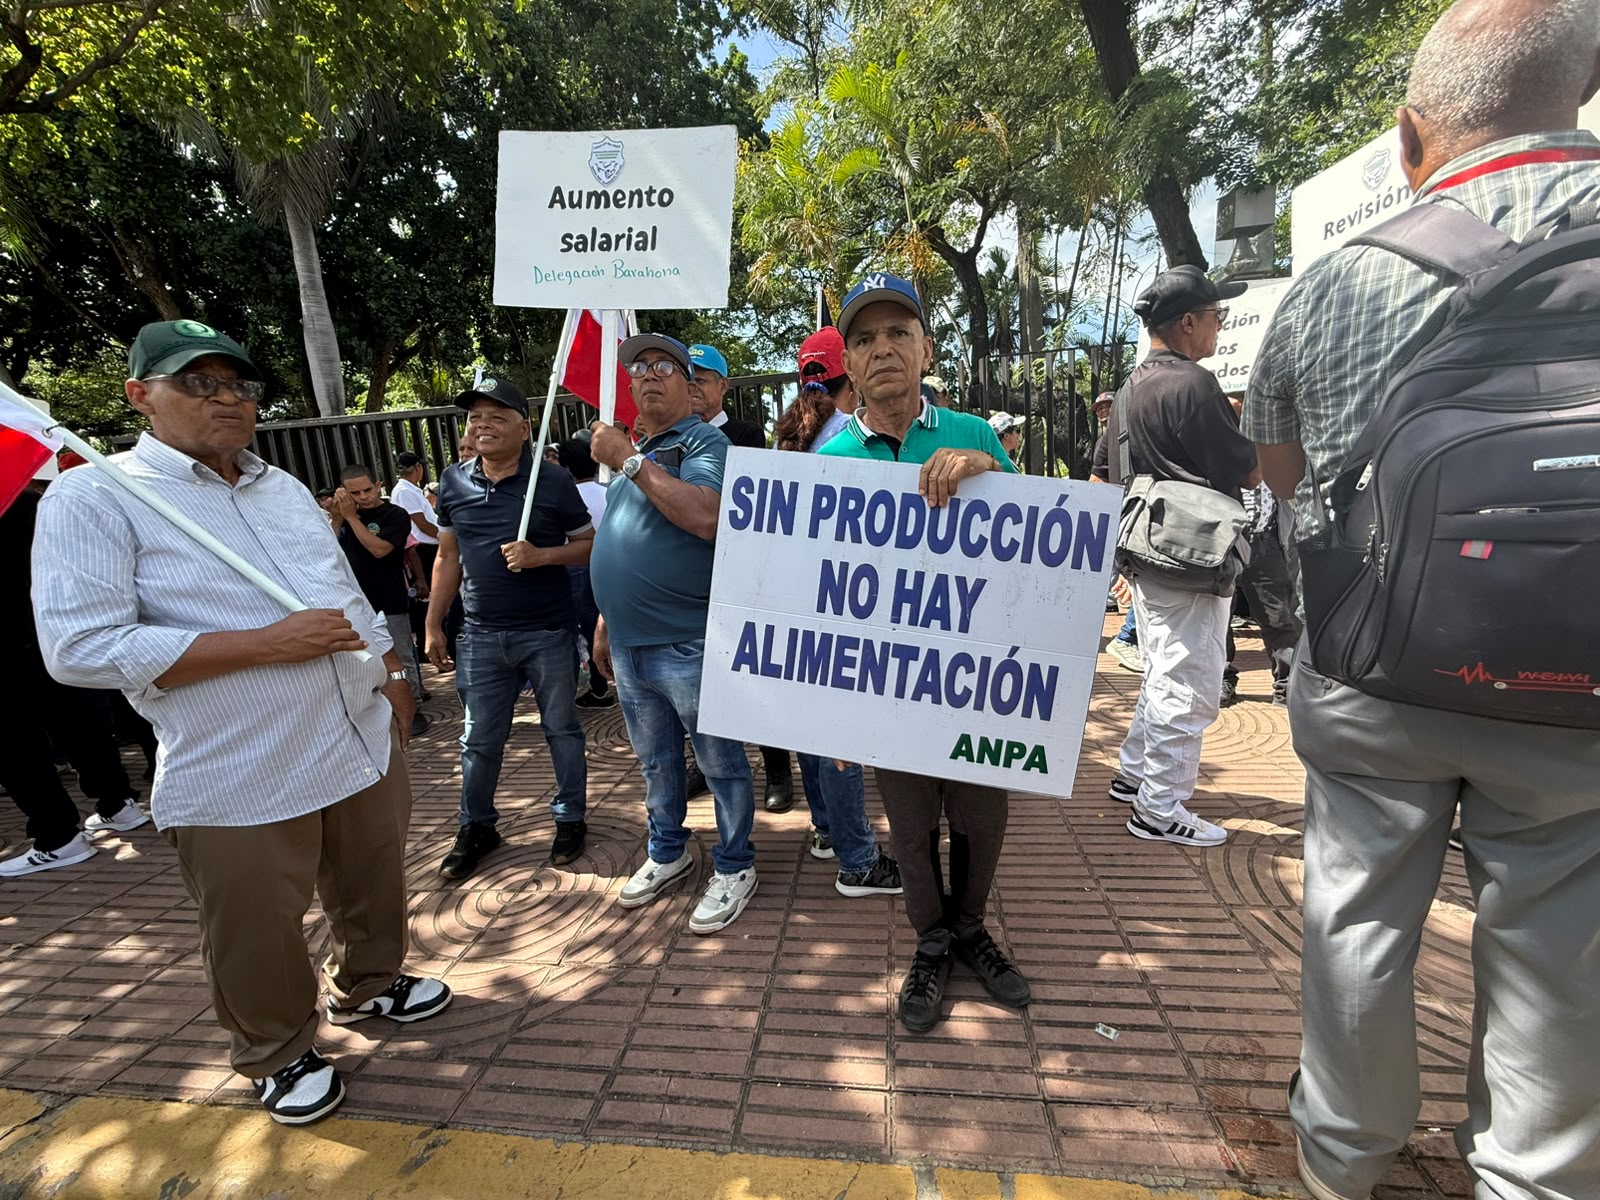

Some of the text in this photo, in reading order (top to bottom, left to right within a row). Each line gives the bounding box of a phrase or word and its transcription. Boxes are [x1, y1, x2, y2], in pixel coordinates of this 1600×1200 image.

[548, 185, 674, 210] Aumento
[1323, 185, 1410, 240] Revisión
[560, 226, 657, 253] salarial
[533, 259, 681, 285] Delegación Barahona
[1222, 312, 1260, 331] ción
[1217, 343, 1238, 355] os
[1211, 362, 1250, 378] dos
[728, 475, 1110, 573] SIN PRODUCCIÓN
[816, 559, 988, 634] NO HAY
[731, 621, 1060, 722] ALIMENTACIÓN
[949, 733, 1048, 775] ANPA
